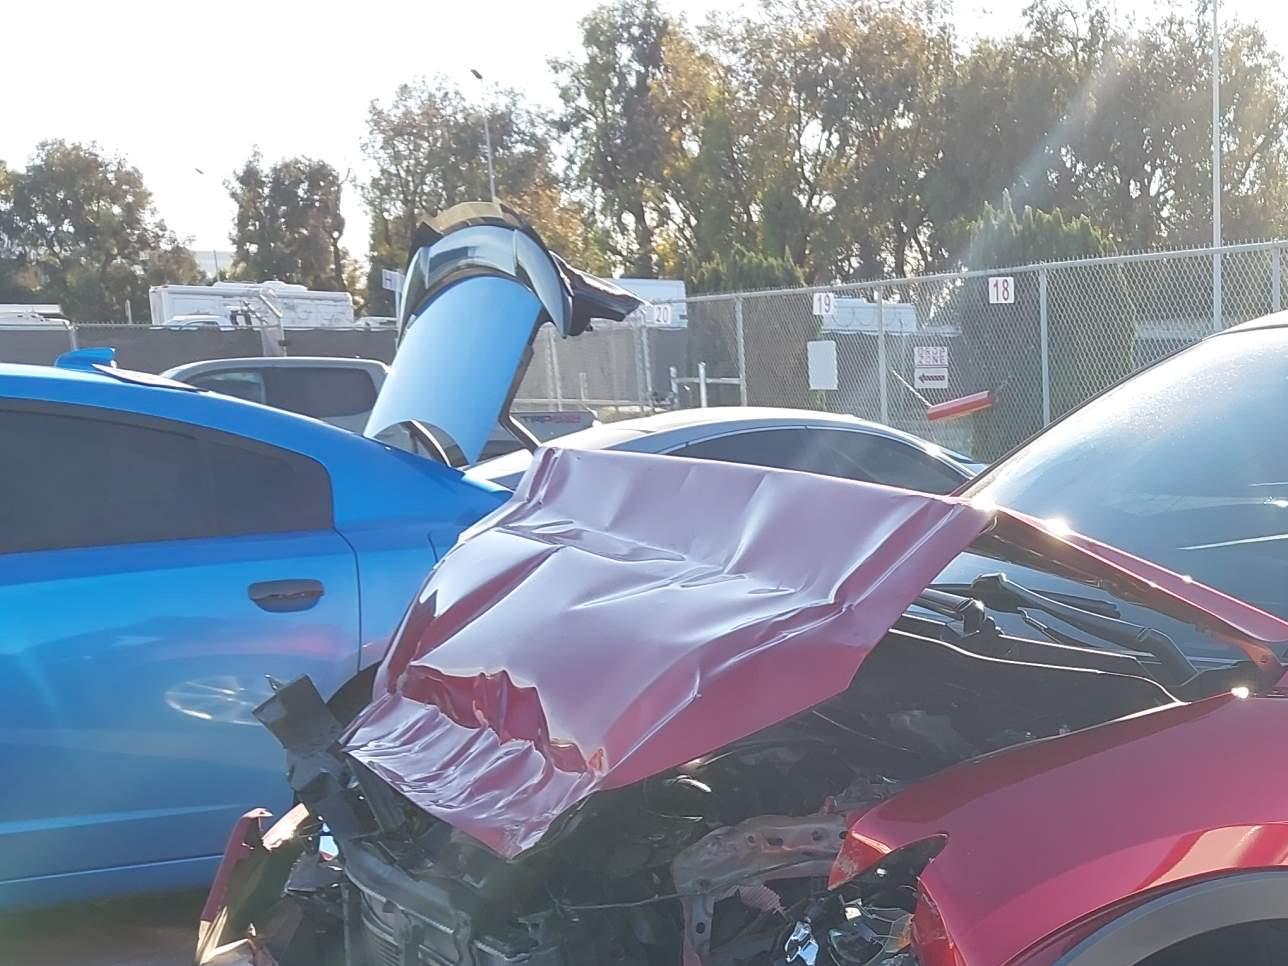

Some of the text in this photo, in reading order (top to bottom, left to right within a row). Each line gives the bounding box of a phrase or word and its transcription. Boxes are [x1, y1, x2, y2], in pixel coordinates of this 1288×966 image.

[993, 279, 1010, 301] 18
[817, 294, 831, 313] 19
[655, 305, 669, 324] 20
